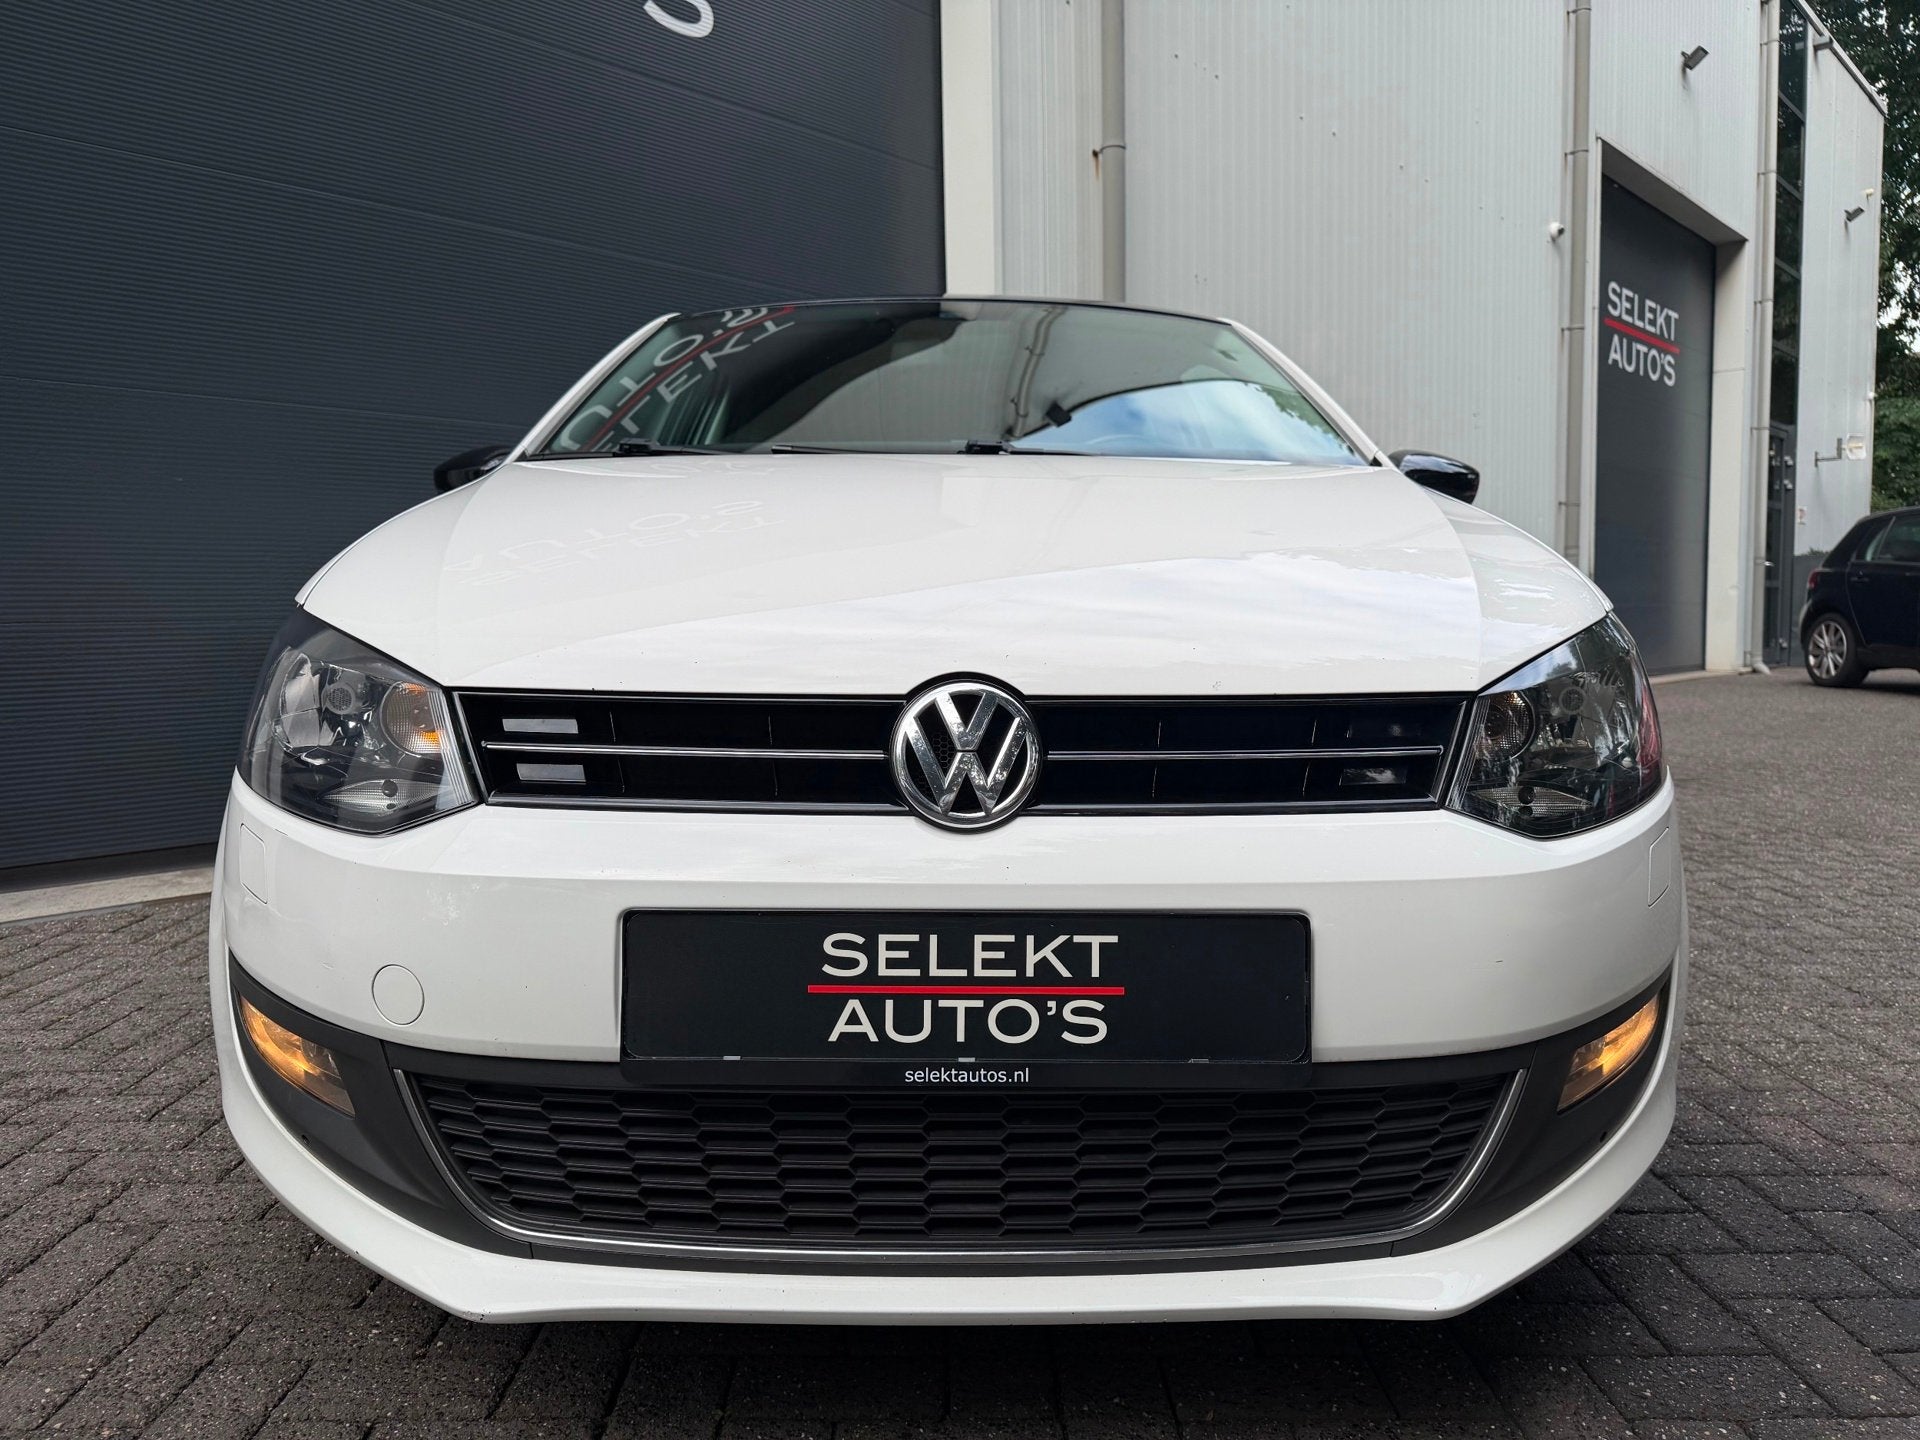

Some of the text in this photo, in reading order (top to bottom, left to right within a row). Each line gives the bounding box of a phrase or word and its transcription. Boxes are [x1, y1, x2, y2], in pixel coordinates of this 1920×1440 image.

[1607, 281, 1679, 341] SELEKT
[1608, 333, 1676, 387] AUTO'S
[821, 932, 1119, 978] SELEKT
[828, 998, 1108, 1045] AUTO'S
[904, 1067, 1030, 1083] selektautos.nl
